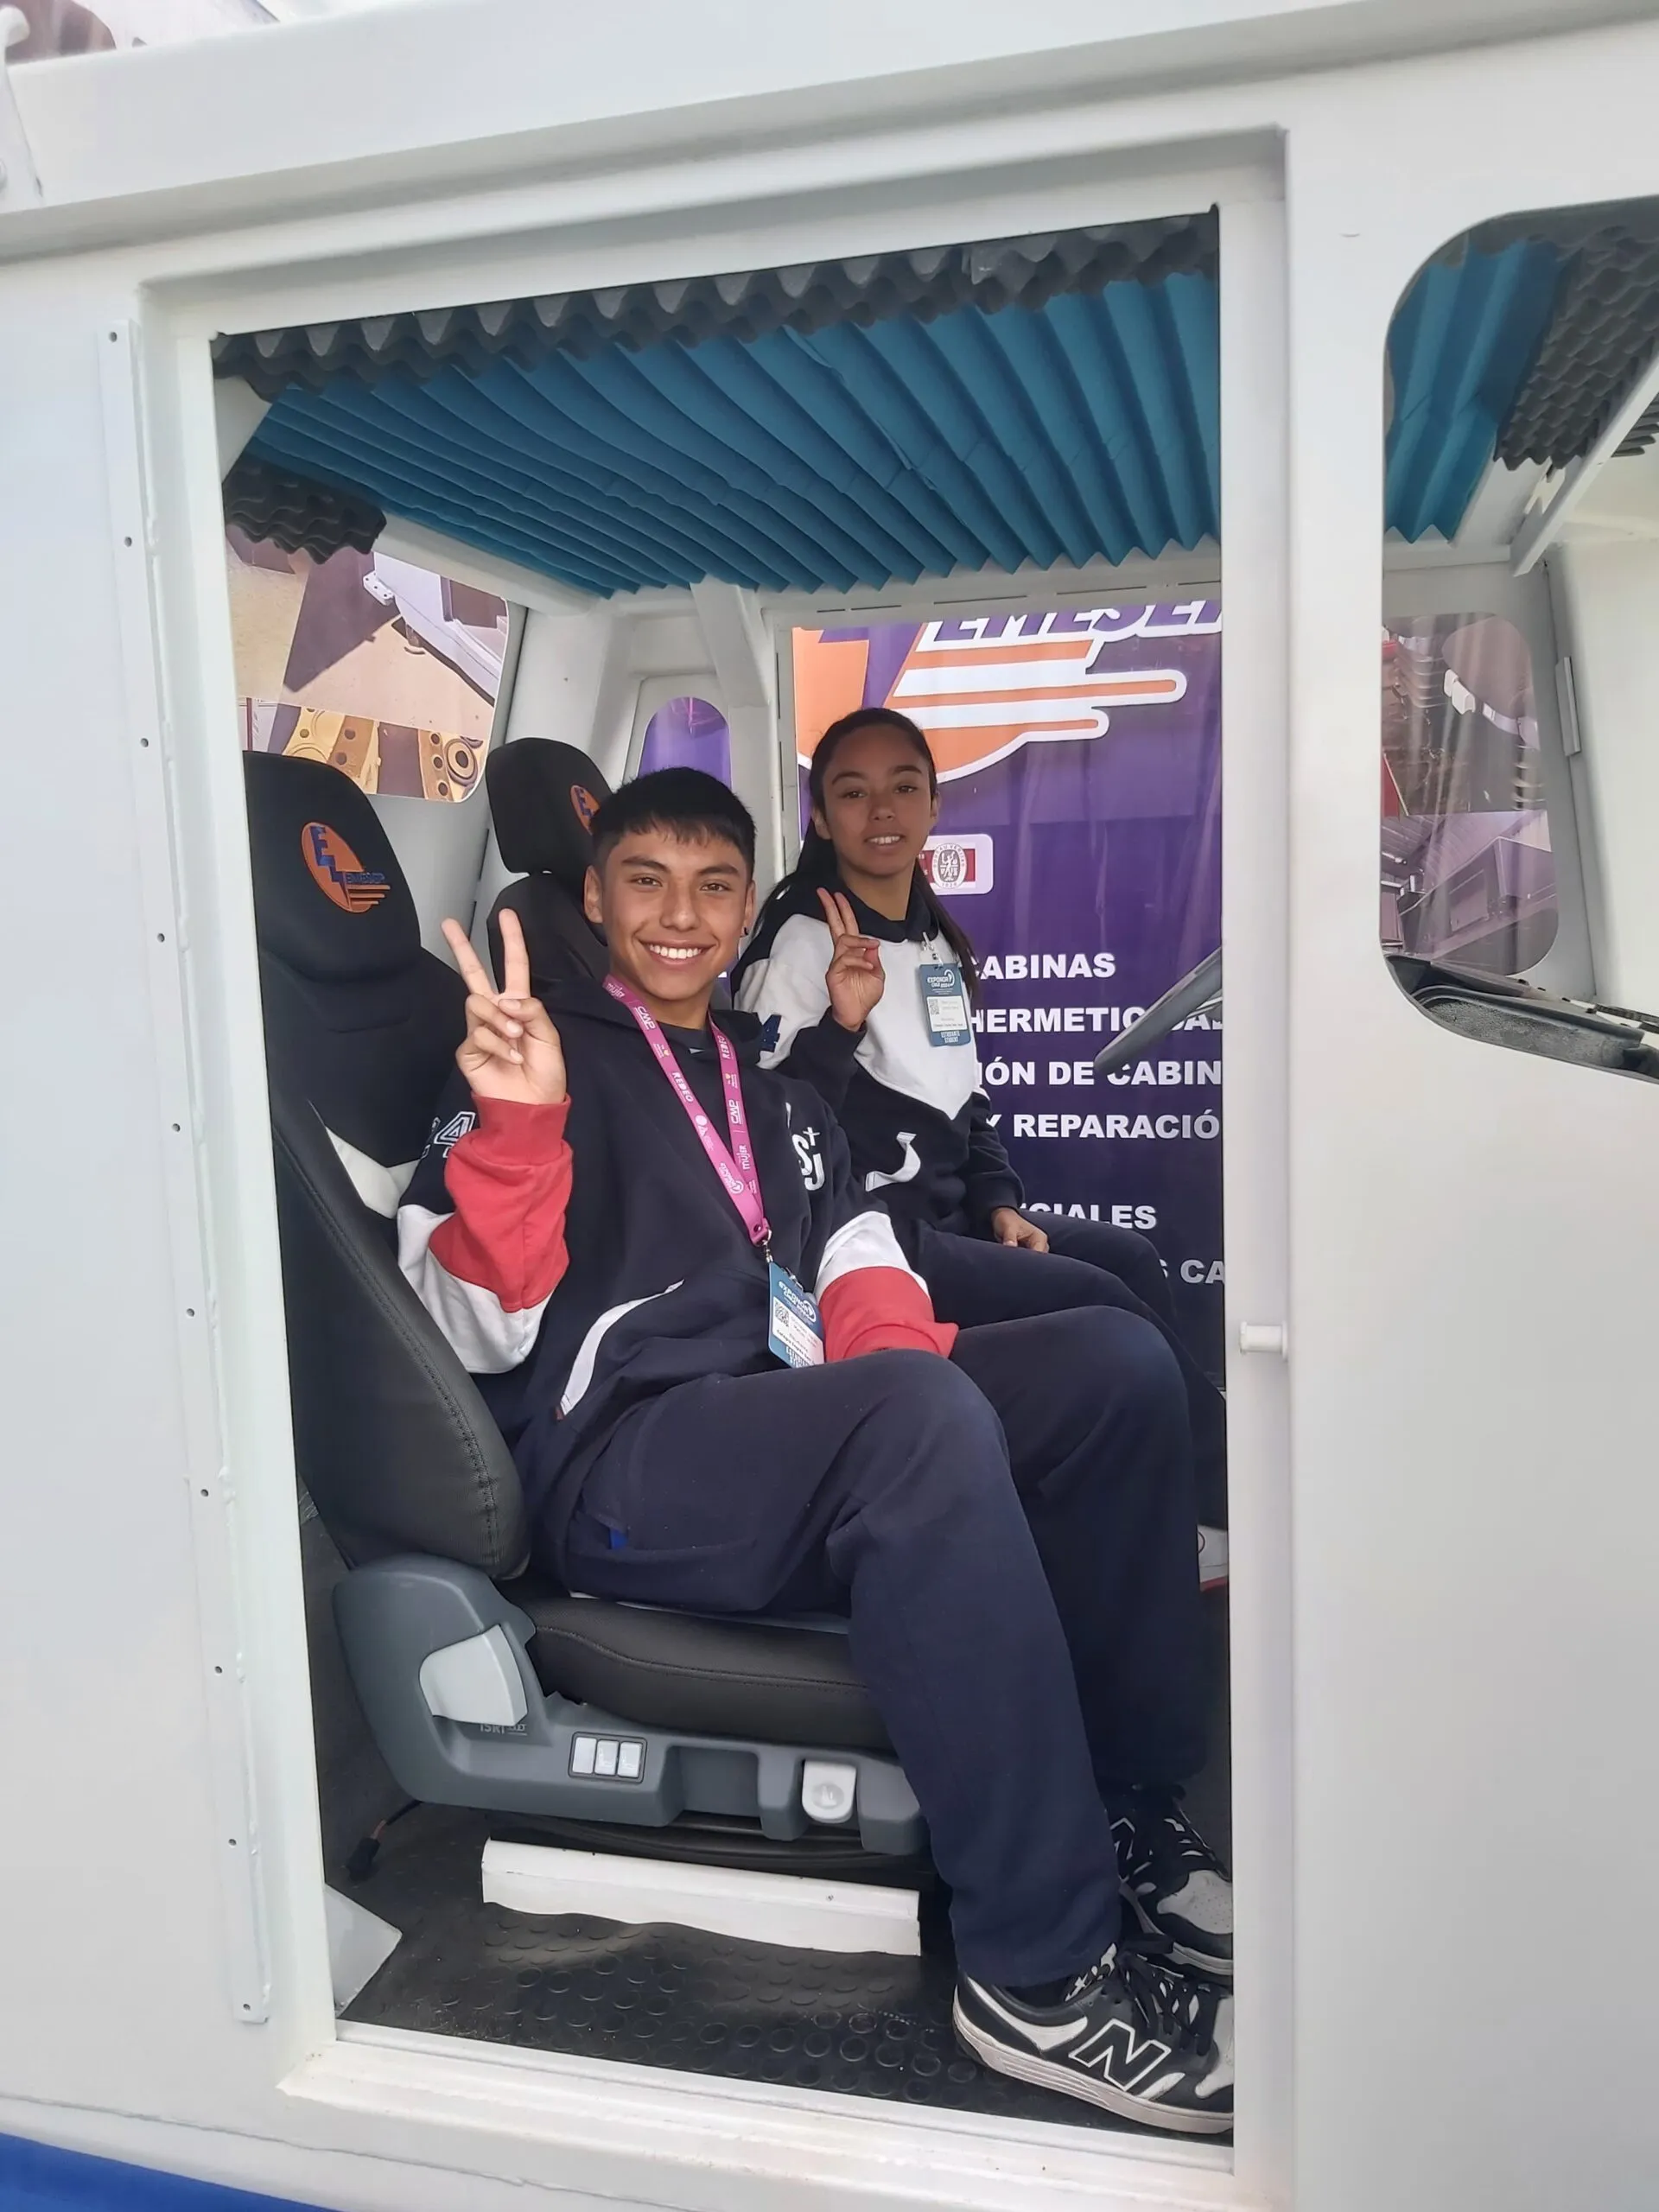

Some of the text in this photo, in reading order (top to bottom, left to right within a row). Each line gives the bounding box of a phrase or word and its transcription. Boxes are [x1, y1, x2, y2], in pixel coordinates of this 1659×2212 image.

[1049, 1061, 1095, 1085] DE
[1014, 1109, 1220, 1139] REPARACIÓ
[1180, 1259, 1225, 1284] CA
